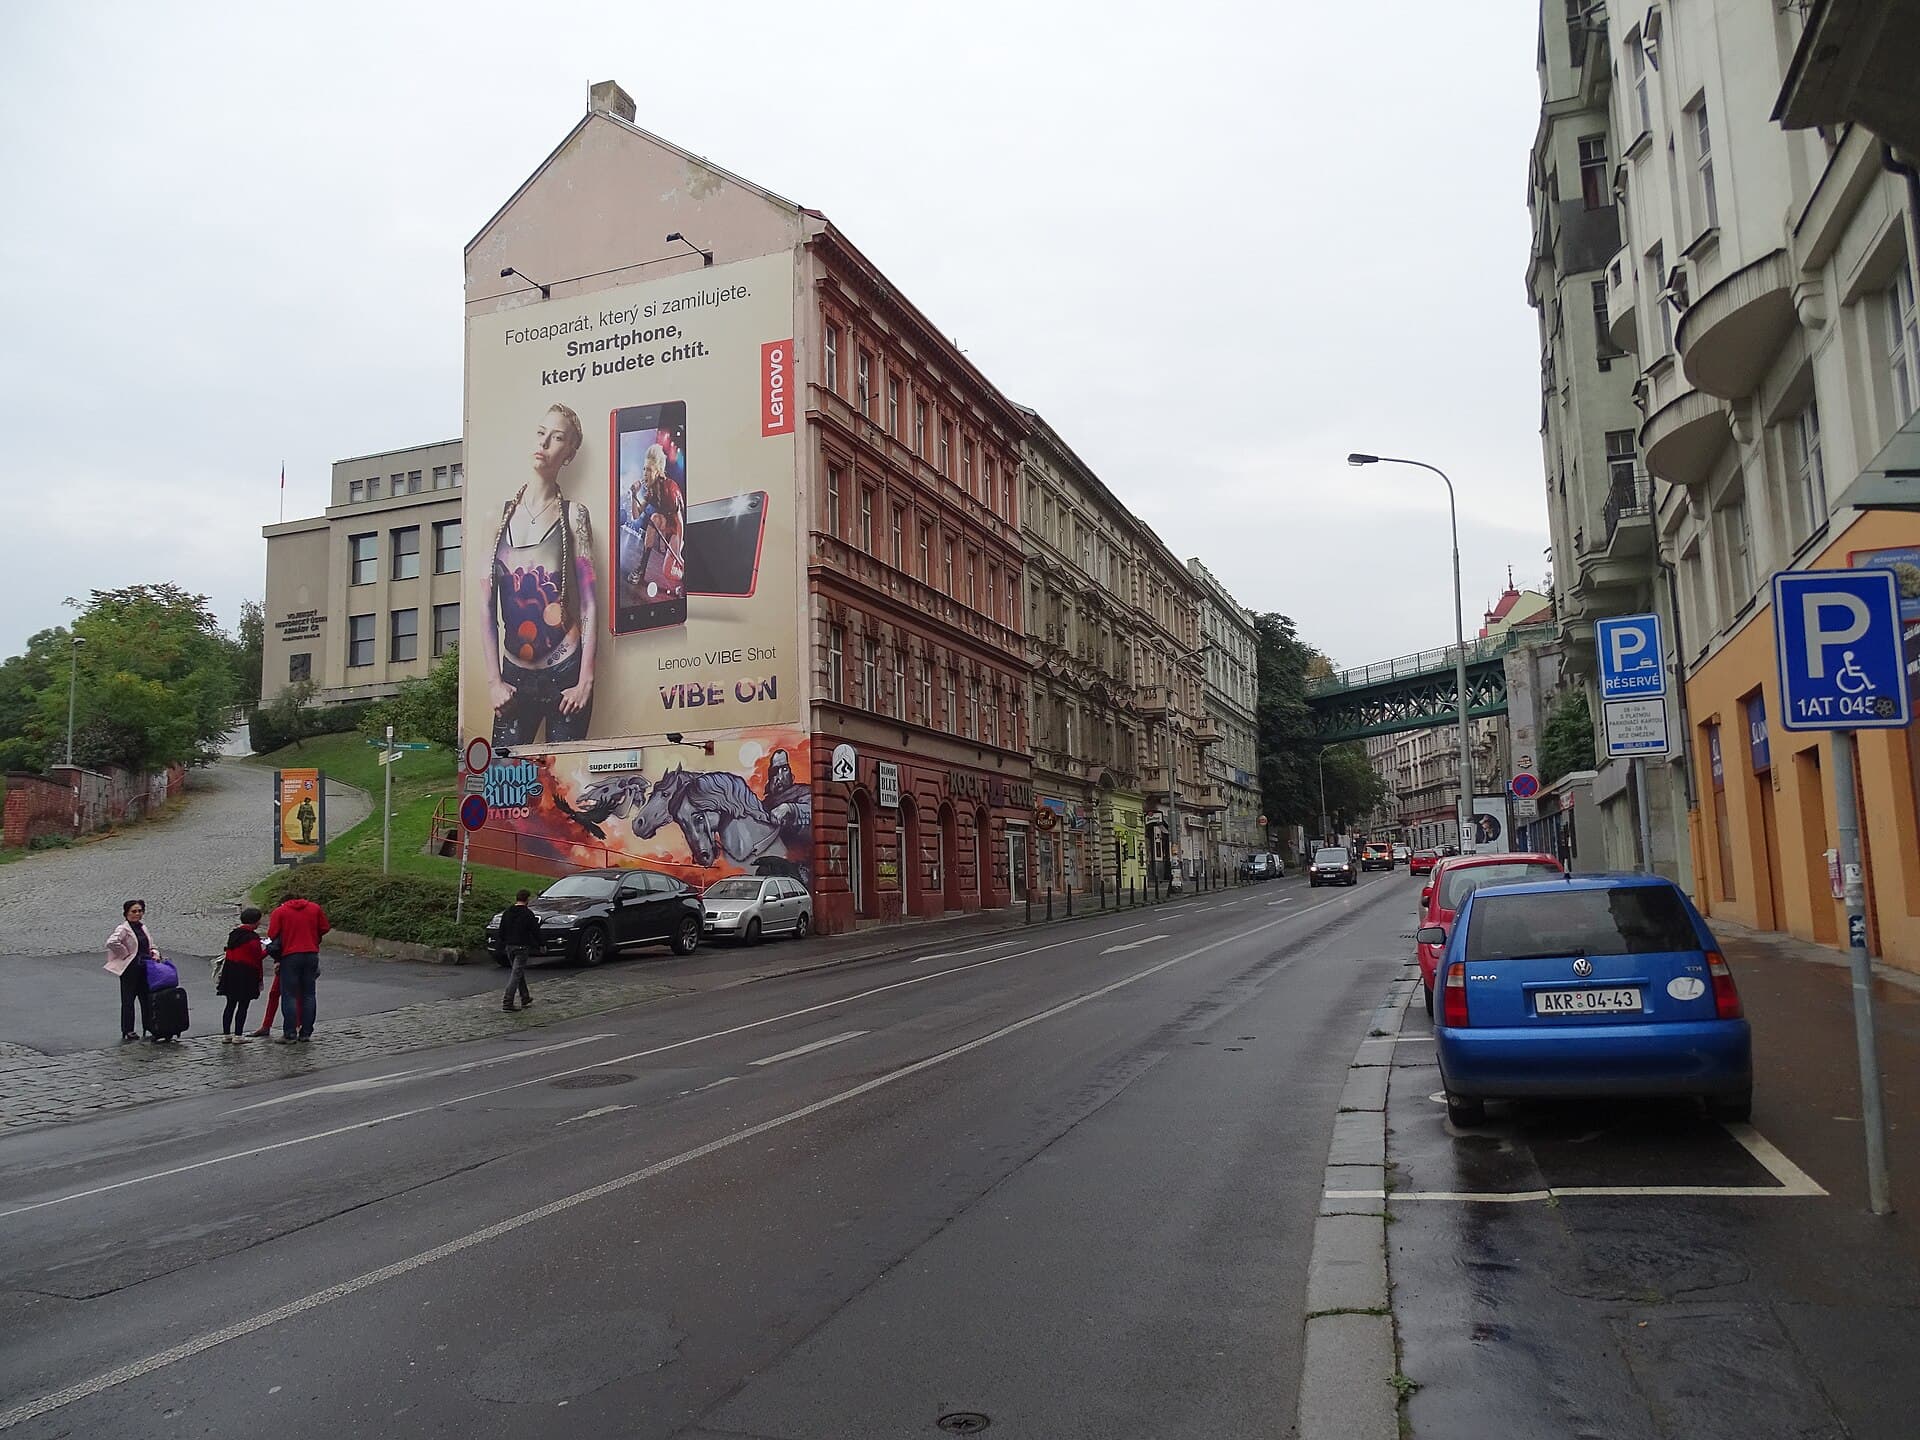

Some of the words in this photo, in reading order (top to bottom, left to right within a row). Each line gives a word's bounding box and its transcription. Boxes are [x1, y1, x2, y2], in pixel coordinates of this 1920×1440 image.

[505, 315, 593, 345] Fotoaparát,
[599, 304, 639, 327] který
[644, 301, 657, 318] si
[662, 284, 752, 314] zamilujete.
[566, 323, 683, 357] Smartphone,
[542, 363, 587, 386] který
[592, 355, 655, 378] budete
[661, 340, 710, 364] chtít.
[768, 347, 784, 429] Lenovo
[1610, 627, 1647, 673] P
[1802, 592, 1871, 679] P
[658, 656, 701, 671] Lenovo
[705, 649, 742, 665] VIBE
[747, 646, 777, 661] Shot
[659, 682, 725, 710] VIBE
[734, 675, 777, 703] ON
[1606, 673, 1660, 689] RÉSERVÉ
[1798, 697, 1834, 716] 1AT
[1545, 993, 1574, 1010] AKR
[1586, 991, 1633, 1008] 04-43
